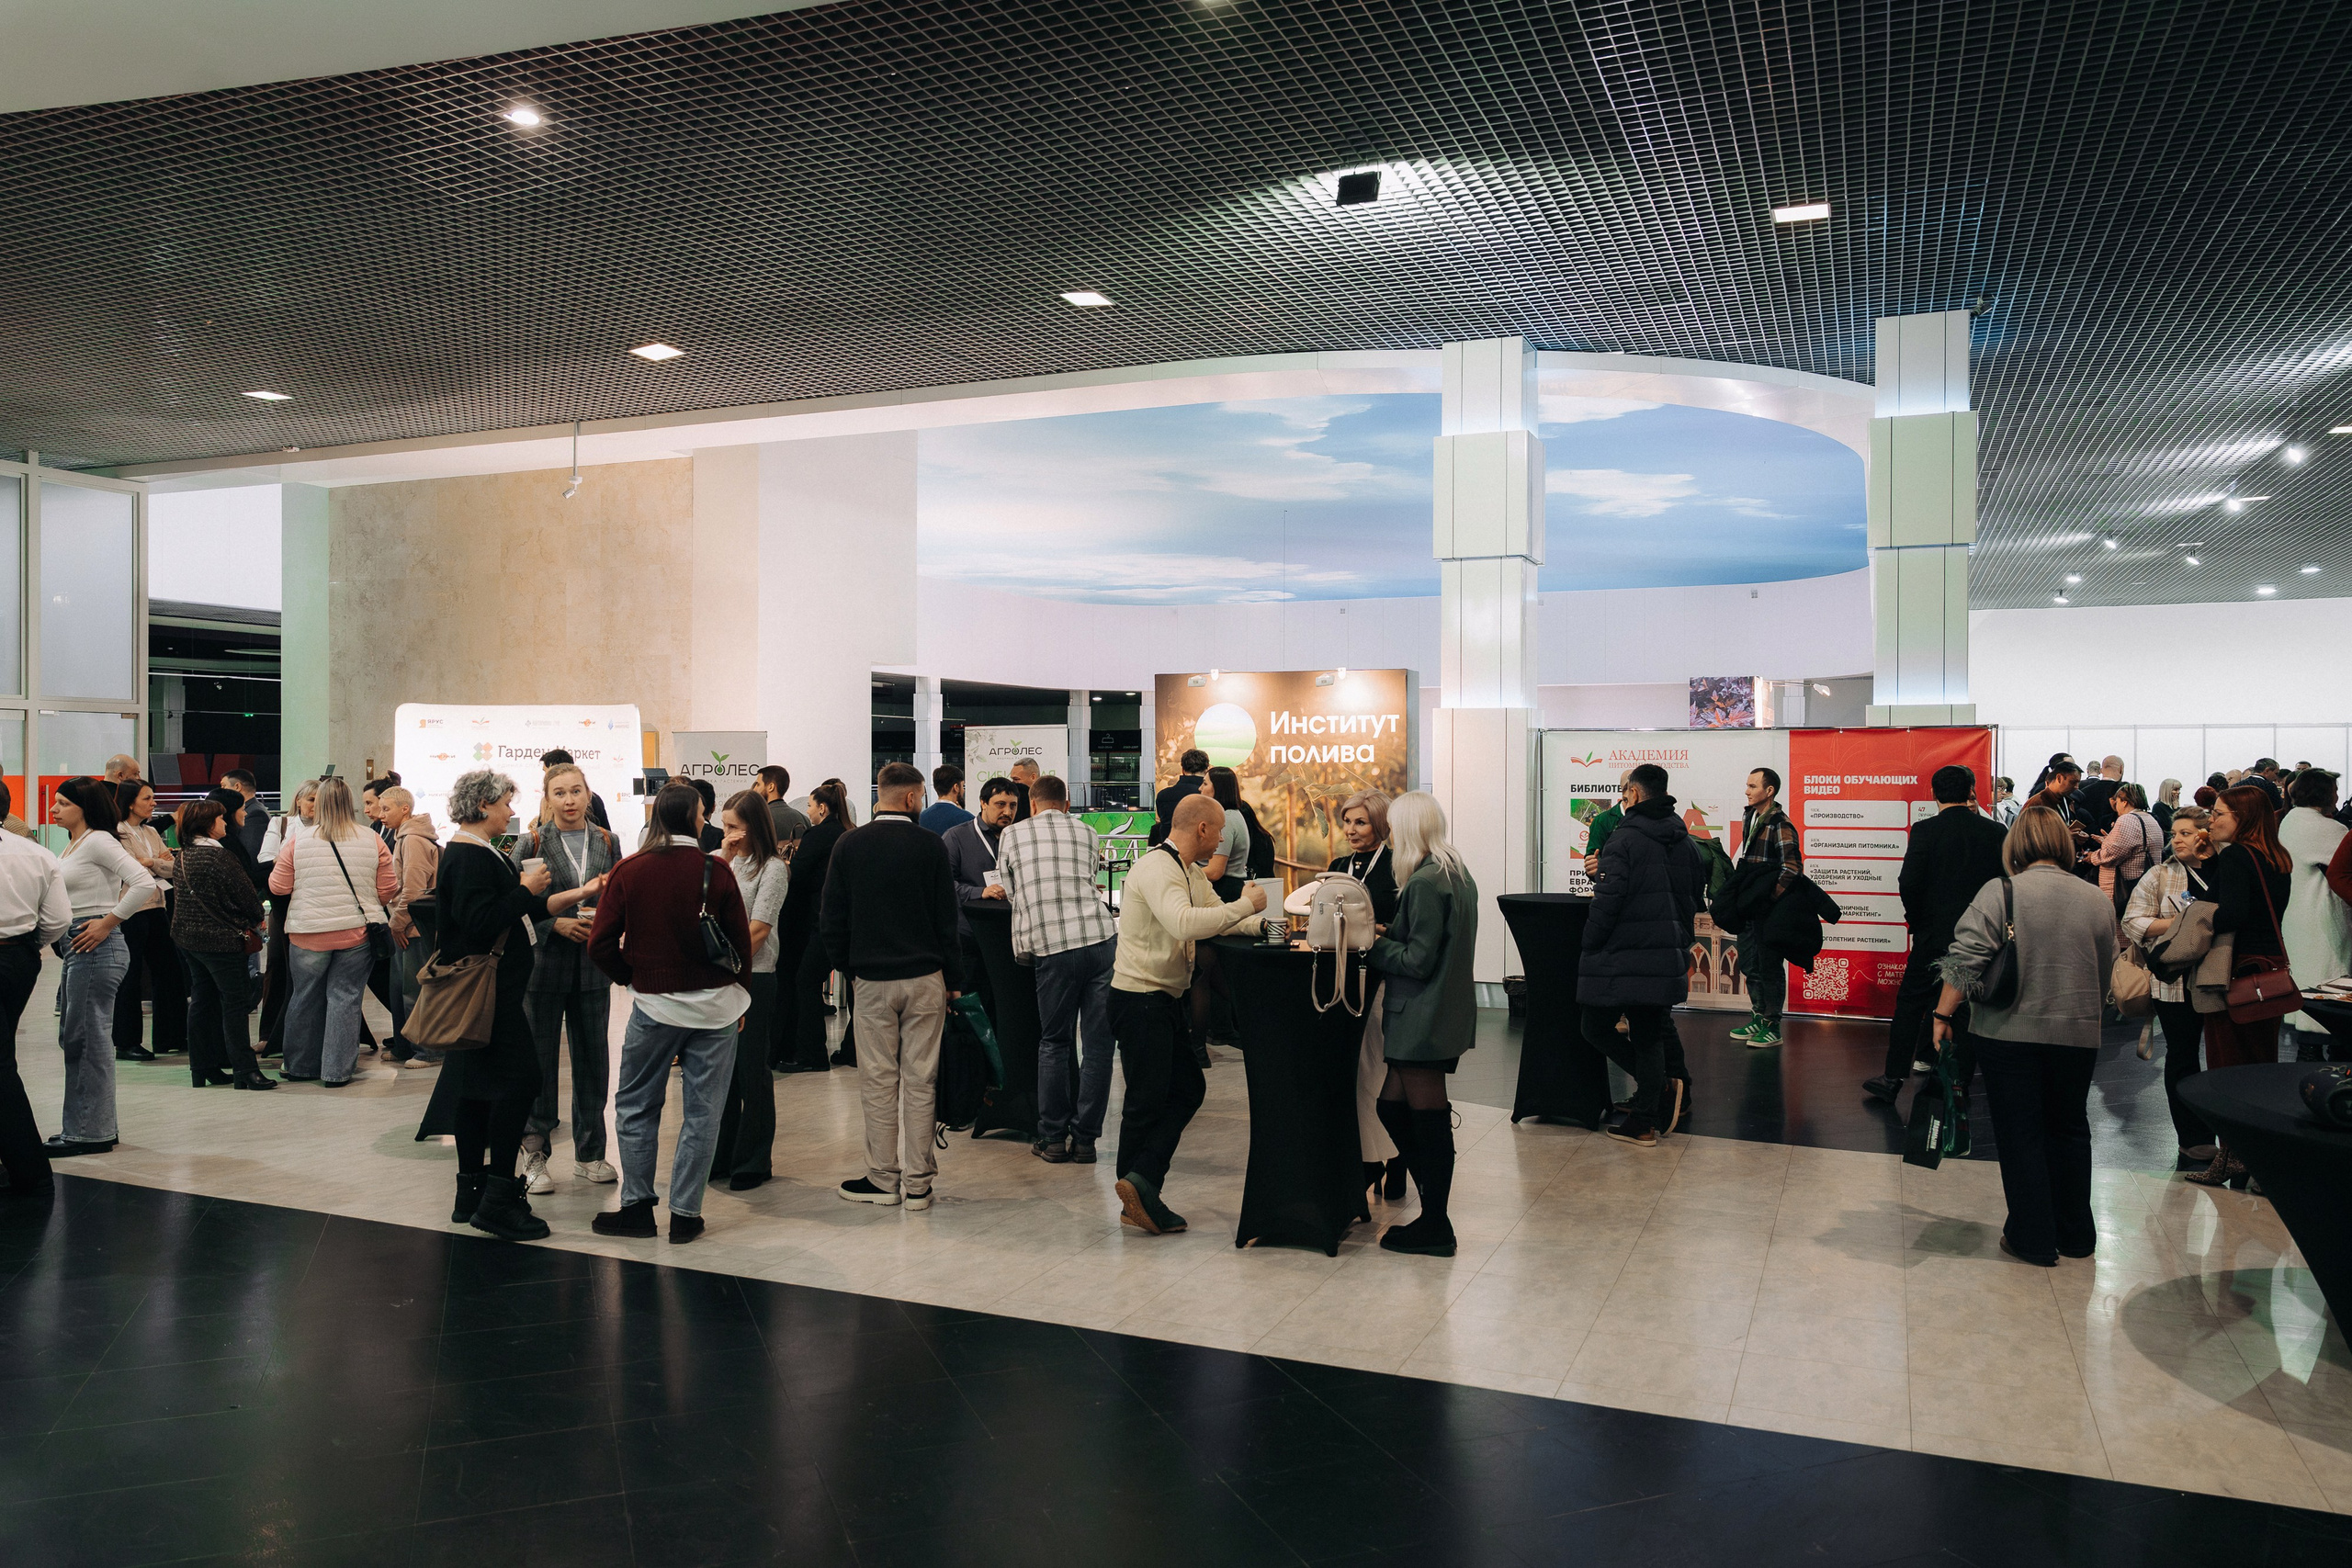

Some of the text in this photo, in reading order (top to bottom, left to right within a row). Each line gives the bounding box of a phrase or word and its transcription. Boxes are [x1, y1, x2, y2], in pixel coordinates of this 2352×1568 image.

[1271, 711, 1400, 739] Институт
[556, 745, 601, 761] аркет
[989, 747, 1043, 756] АГРОЛЕС
[1270, 744, 1374, 763] полива
[1609, 750, 1689, 761] АКАДЕМИЯ
[680, 763, 760, 776] АГРОЛЕС
[1804, 775, 1917, 785] БЛОКИ ОБУЧАЮЩИХ
[1570, 784, 1623, 793] БИБЛИОТЕ
[1804, 785, 1840, 795] ВИДЕО
